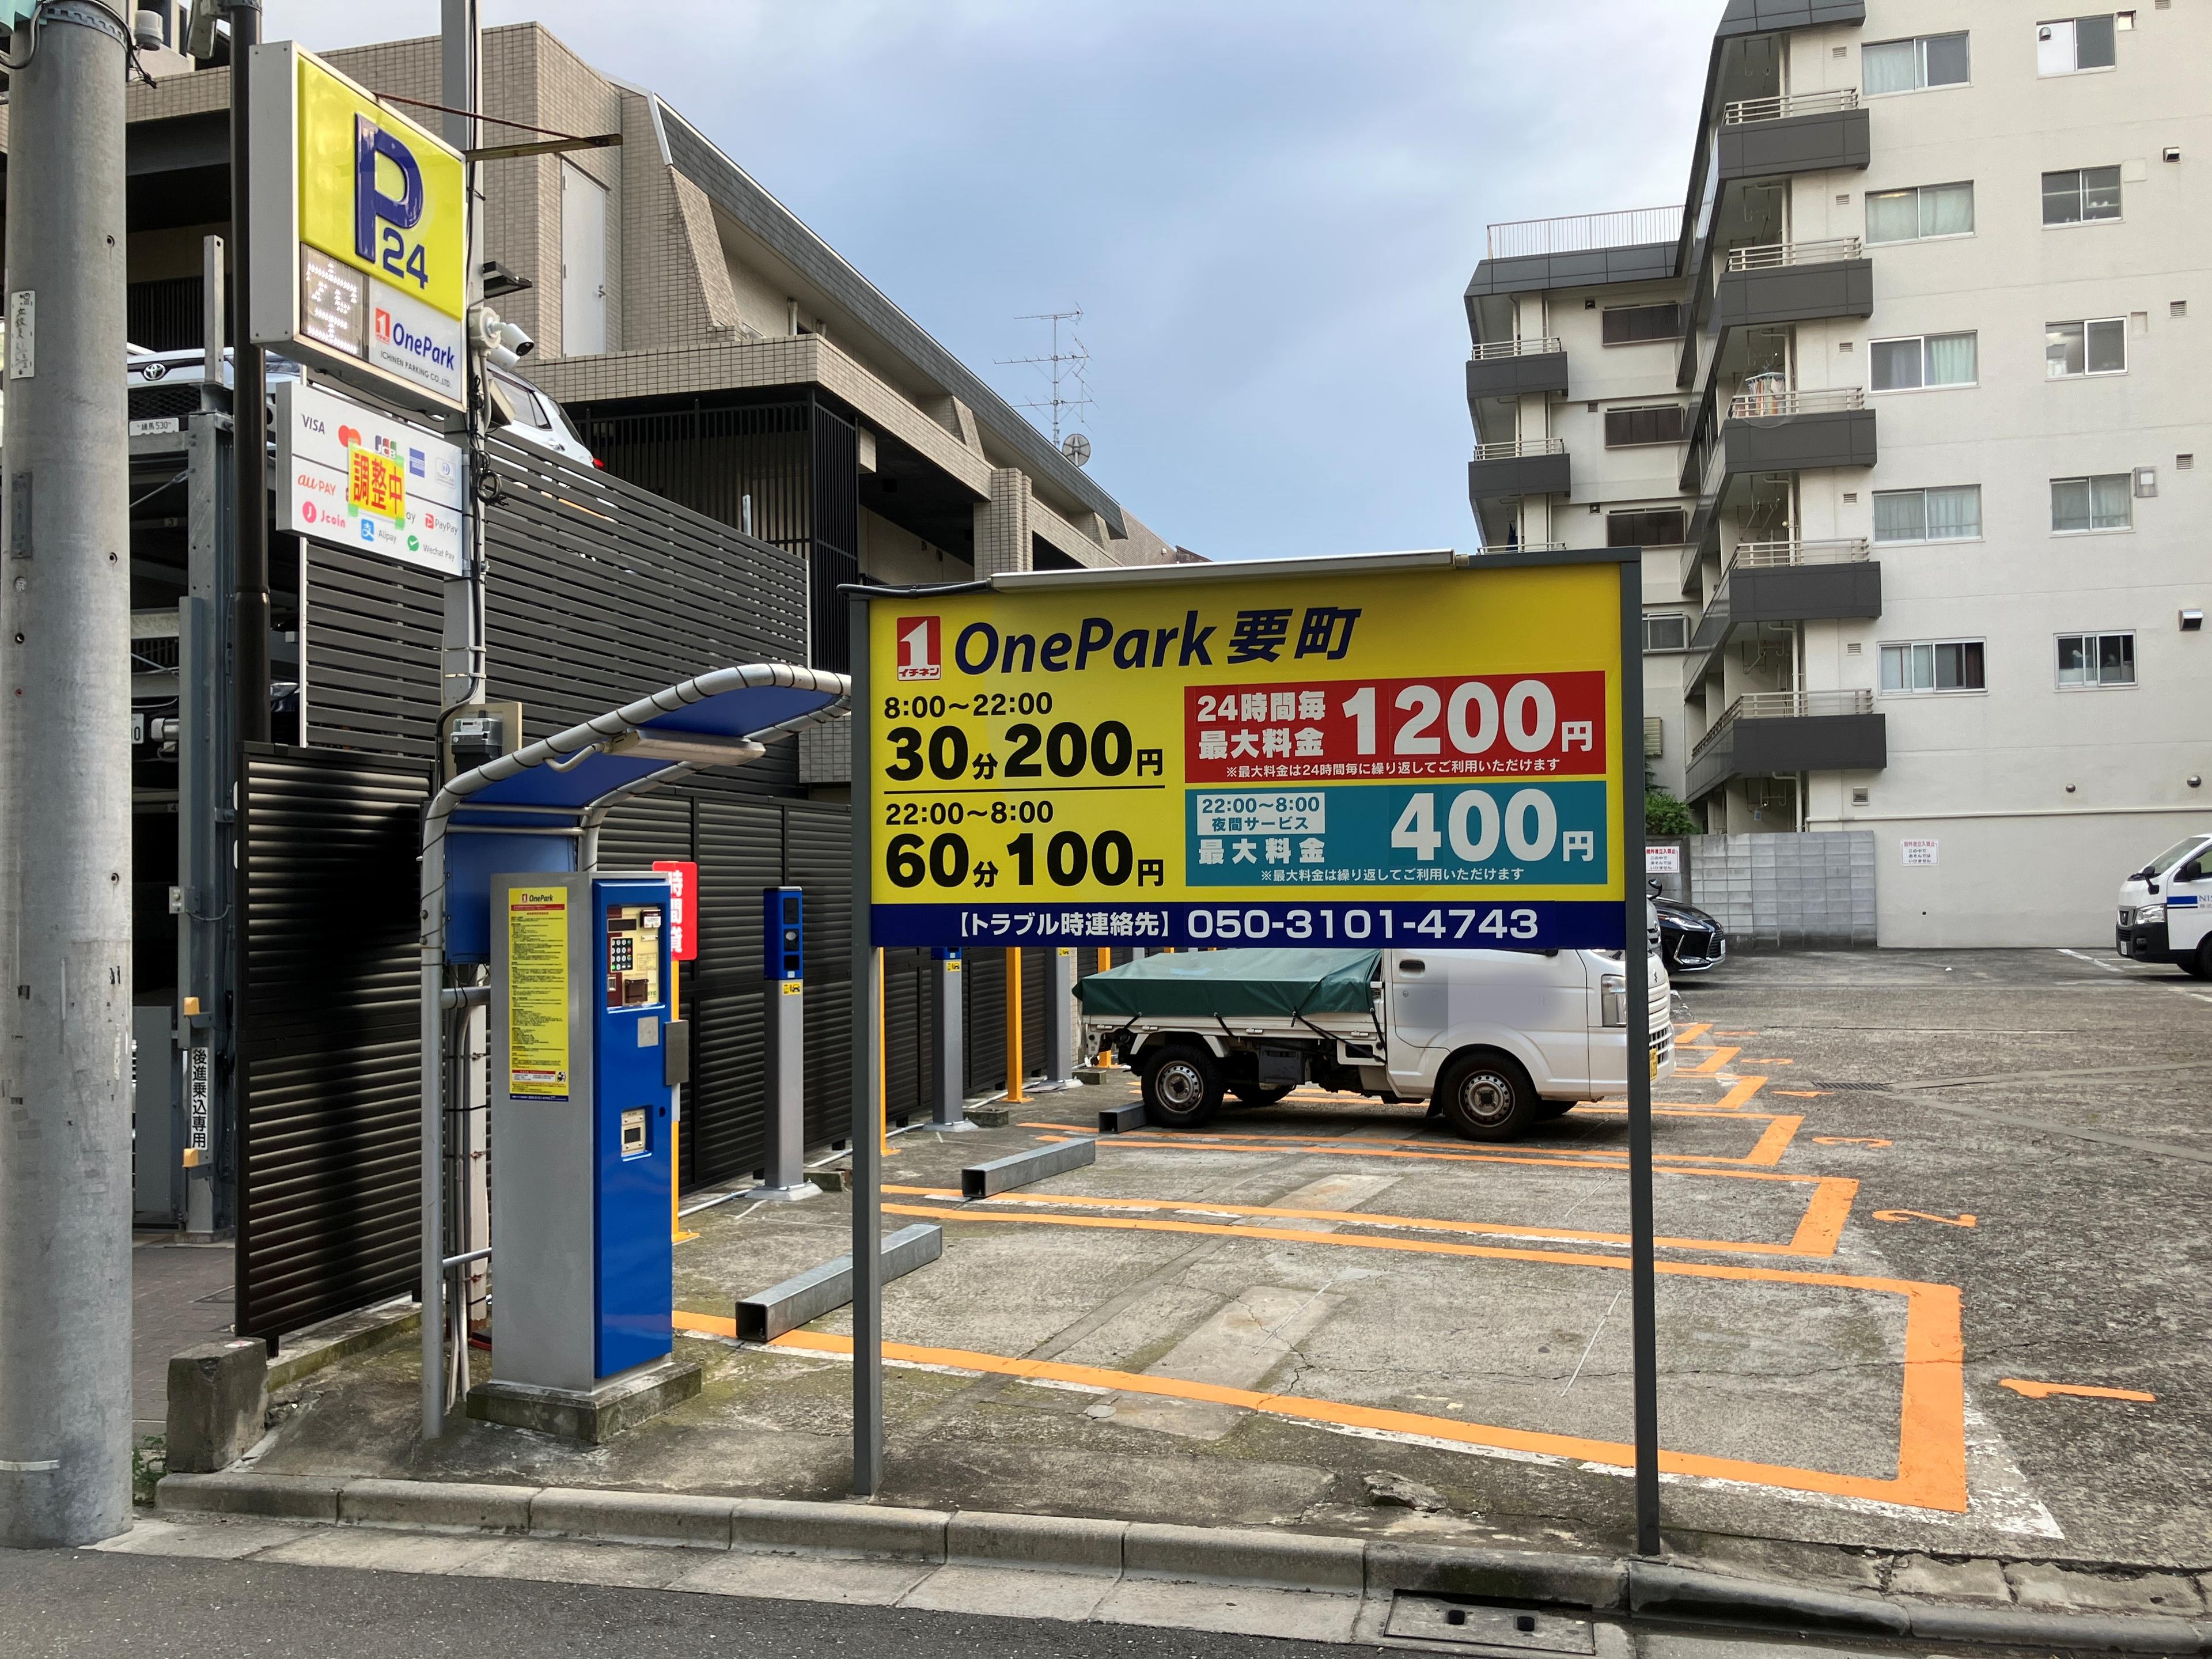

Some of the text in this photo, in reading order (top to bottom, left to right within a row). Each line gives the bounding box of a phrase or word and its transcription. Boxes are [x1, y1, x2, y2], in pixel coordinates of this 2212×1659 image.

[355, 111, 429, 290] P 24
[393, 323, 455, 370] OnePark
[381, 350, 404, 367] ICHINEN
[405, 361, 429, 378] PARKING
[155, 421, 168, 430] 530
[301, 414, 325, 435] VISA
[375, 444, 397, 460] JCB
[319, 479, 336, 497] PAY
[353, 452, 403, 514] 調整中
[320, 510, 346, 528] Jcoin
[406, 512, 416, 524] ay
[434, 518, 459, 536] PayPay
[378, 529, 397, 544] Alipay
[445, 550, 455, 562] Pay
[955, 610, 1218, 676] OnePark
[1227, 607, 1362, 665] 要町
[899, 668, 940, 677] イチネン
[884, 692, 1053, 719] 8:00～22:00
[1197, 691, 1325, 723] 24時間毎
[1342, 679, 1593, 756] 1200円
[1198, 728, 1325, 760] 最大料金
[1226, 757, 1560, 778] ※最大料金は24時間毎に繰り返してご利用いただけます
[885, 800, 1054, 825] 22:00～8:00
[1201, 796, 1320, 814] 22:00～8:00
[1211, 816, 1309, 832] 夜間サービス
[1391, 788, 1594, 862] 400円
[1198, 838, 1325, 865] 最大料金
[1260, 868, 1525, 882] ※最大料金は繰り返してご利用いただけます
[529, 893, 554, 902] OnePark
[961, 908, 1539, 940] 【トラブル時連絡先】 050-3101-4743
[192, 1048, 207, 1148] 後進乗込専用
[1812, 1137, 1893, 1147] 3
[1872, 1209, 1977, 1228] 2
[1998, 1378, 2157, 1402] 1
